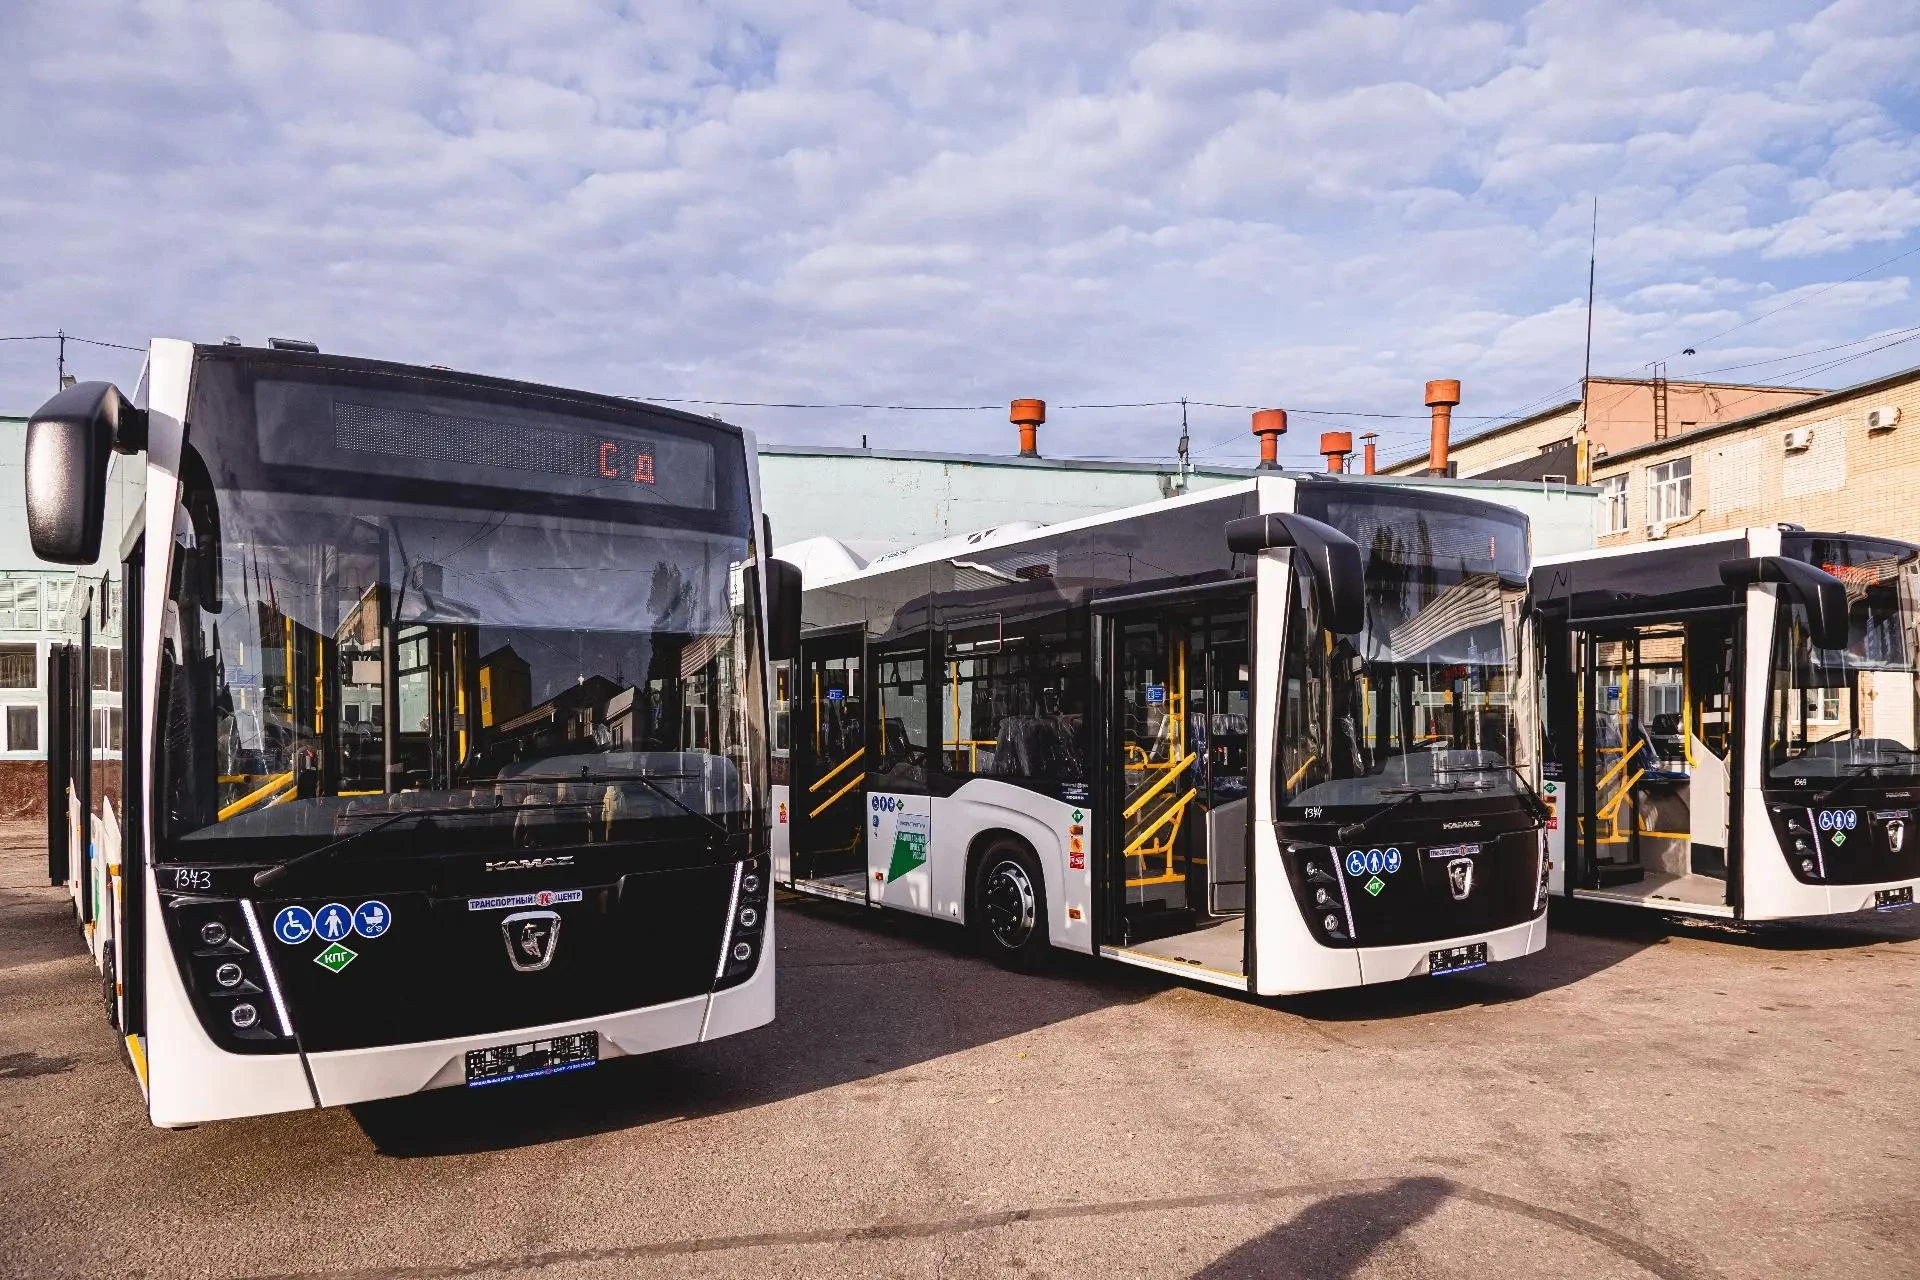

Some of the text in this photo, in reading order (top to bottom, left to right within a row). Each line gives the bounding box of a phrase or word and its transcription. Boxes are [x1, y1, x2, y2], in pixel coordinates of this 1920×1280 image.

[470, 894, 533, 909] ТРАНСПОРТНЫЙ
[556, 891, 581, 902] ЦЕНТР
[324, 951, 348, 964] КПГ
